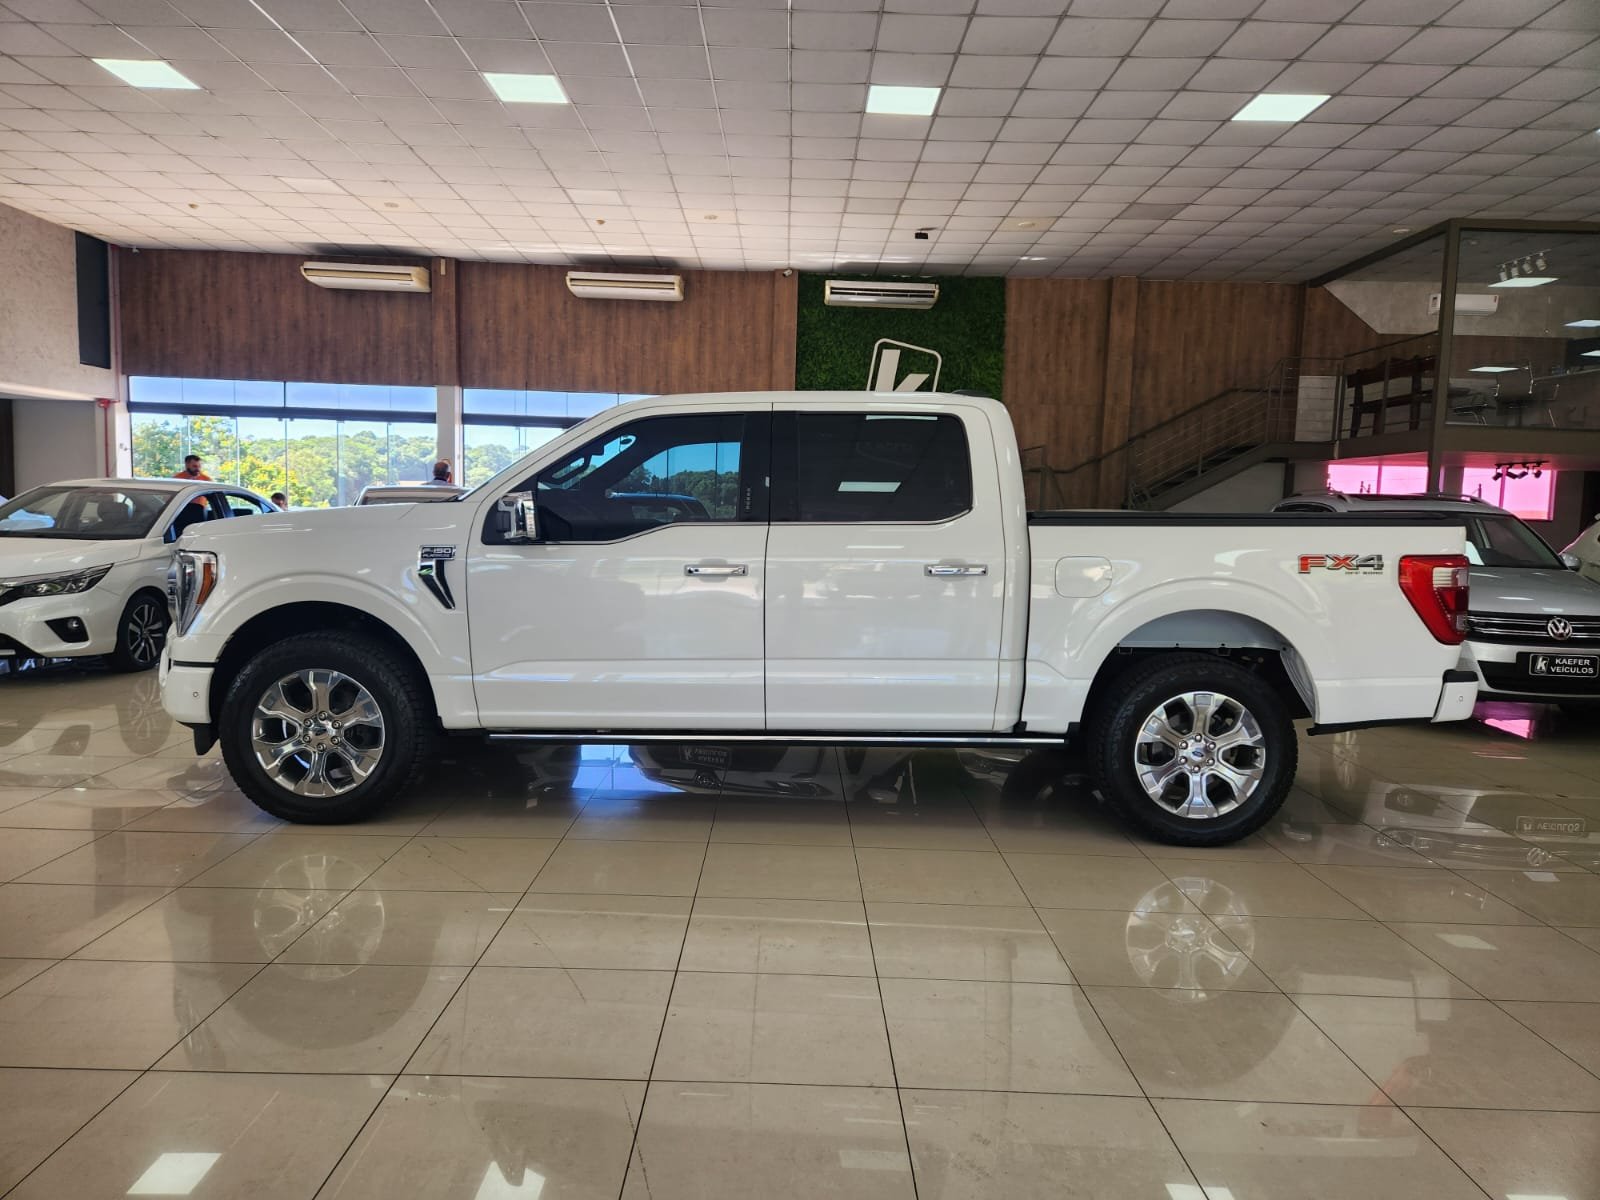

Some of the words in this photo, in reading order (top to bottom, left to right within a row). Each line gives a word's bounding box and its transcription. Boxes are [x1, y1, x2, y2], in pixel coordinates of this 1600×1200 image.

[1298, 554, 1384, 574] FX4
[1555, 658, 1590, 666] KAEFER
[1551, 665, 1594, 674] VEÍCULOS
